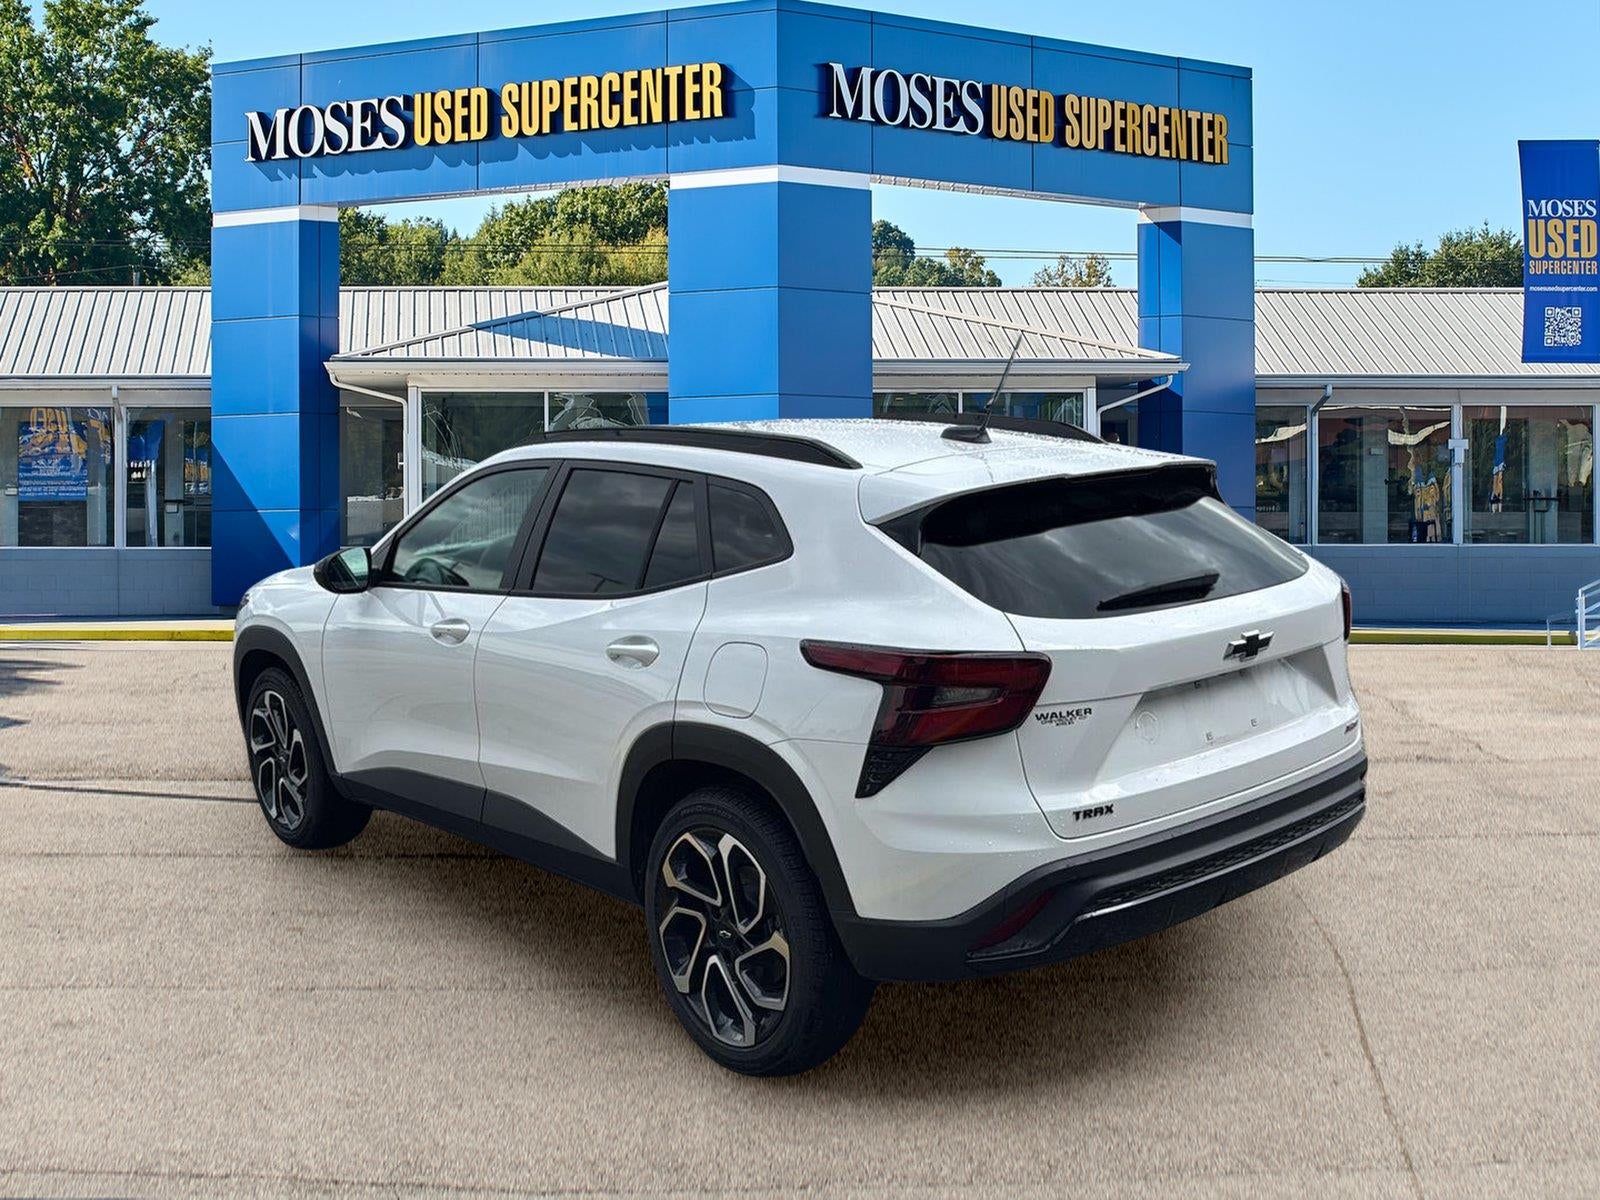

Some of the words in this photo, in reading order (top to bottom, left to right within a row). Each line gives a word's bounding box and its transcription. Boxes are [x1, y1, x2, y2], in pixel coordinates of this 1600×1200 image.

[243, 95, 407, 163] MOSES
[413, 86, 489, 146] USED
[500, 62, 724, 138] SUPERCENTER
[827, 61, 985, 135] MOSES
[991, 84, 1055, 143] USED
[1064, 93, 1229, 164] SUPERCENTER
[1527, 199, 1597, 217] MOSES
[1528, 218, 1598, 259] USED
[1529, 260, 1598, 275] SUPERCENTER
[1529, 285, 1598, 293] mosesusedsupercenter.com
[1035, 707, 1092, 721] WALKER
[1072, 803, 1114, 822] TRAX
